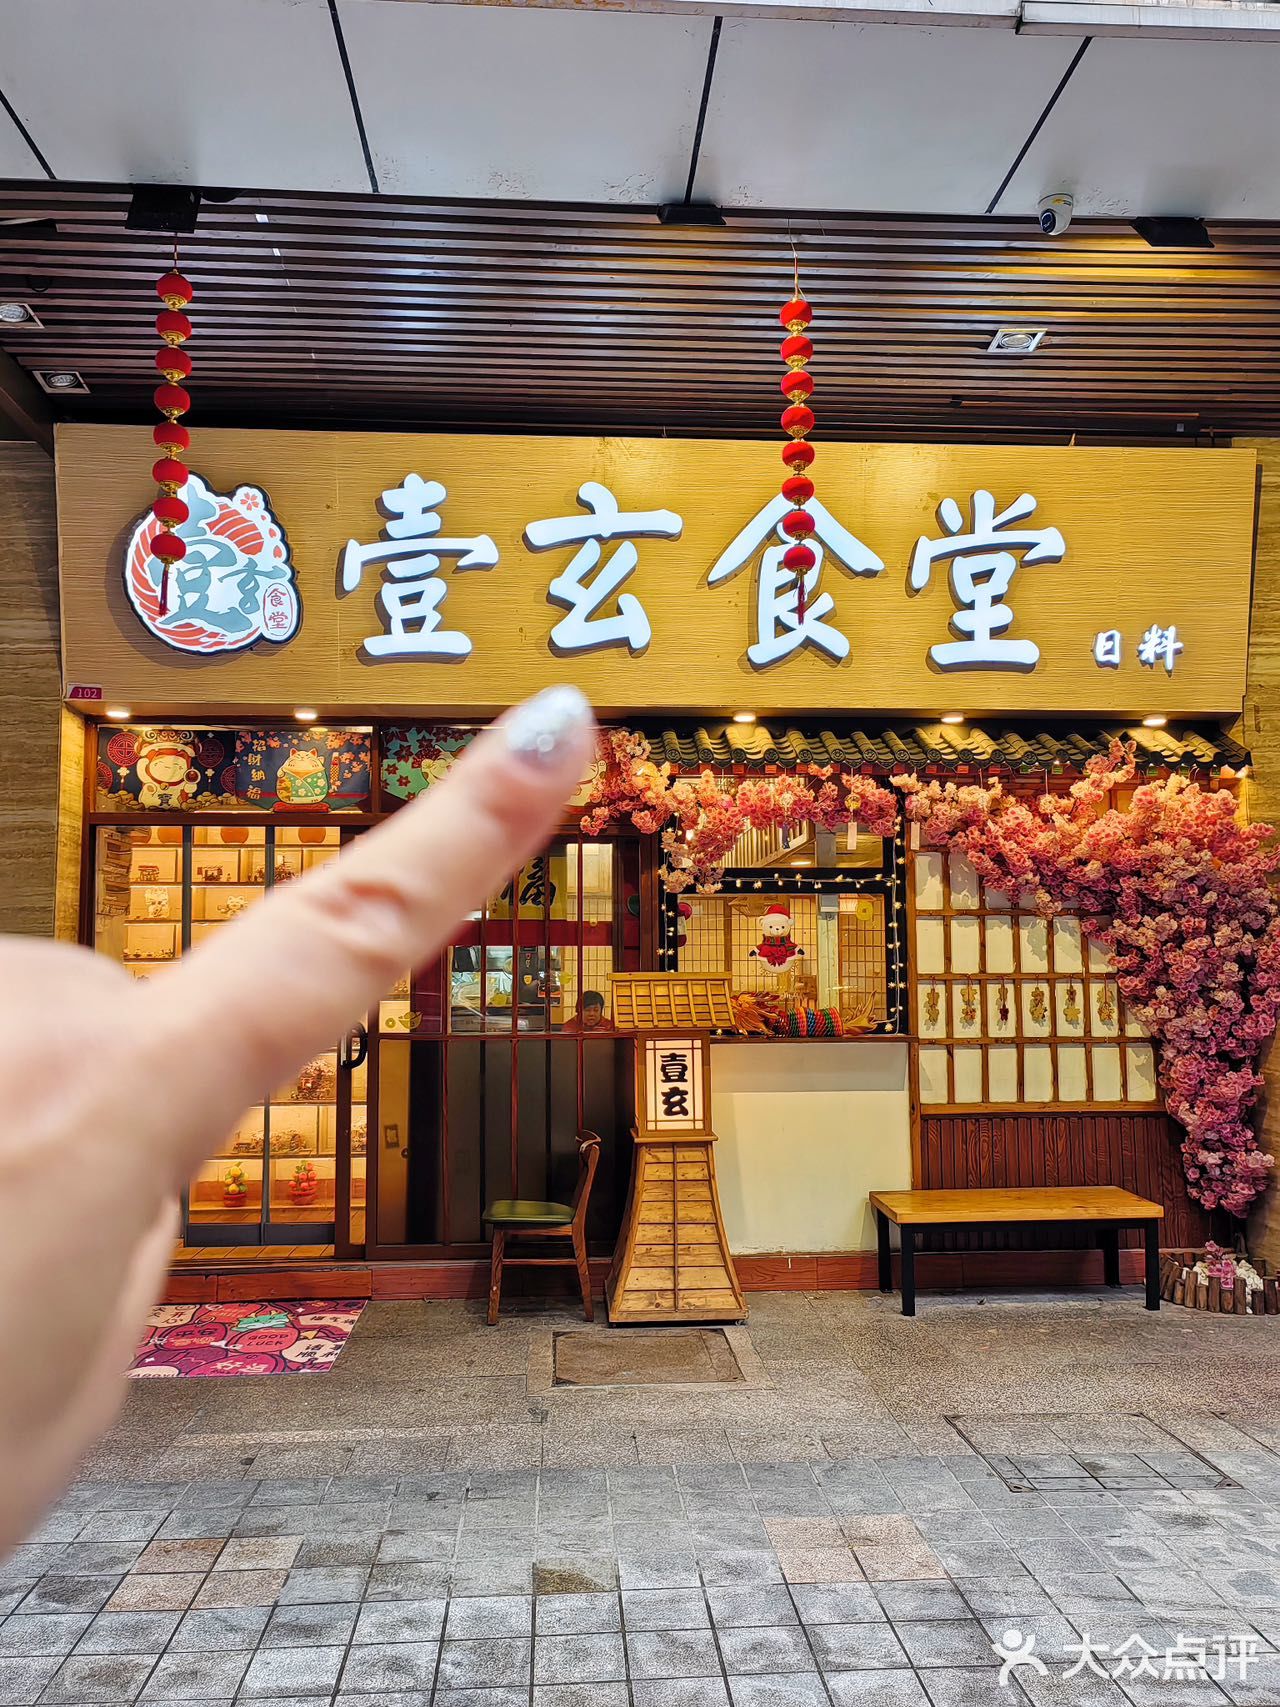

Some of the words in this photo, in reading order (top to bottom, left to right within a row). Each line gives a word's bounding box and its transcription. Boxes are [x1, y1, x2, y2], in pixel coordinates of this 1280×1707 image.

[342, 473, 1065, 665] 壹玄食堂
[268, 588, 289, 630] 食堂
[1094, 624, 1183, 671] 日料
[77, 688, 97, 698] 102
[660, 1052, 689, 1116] 壹玄
